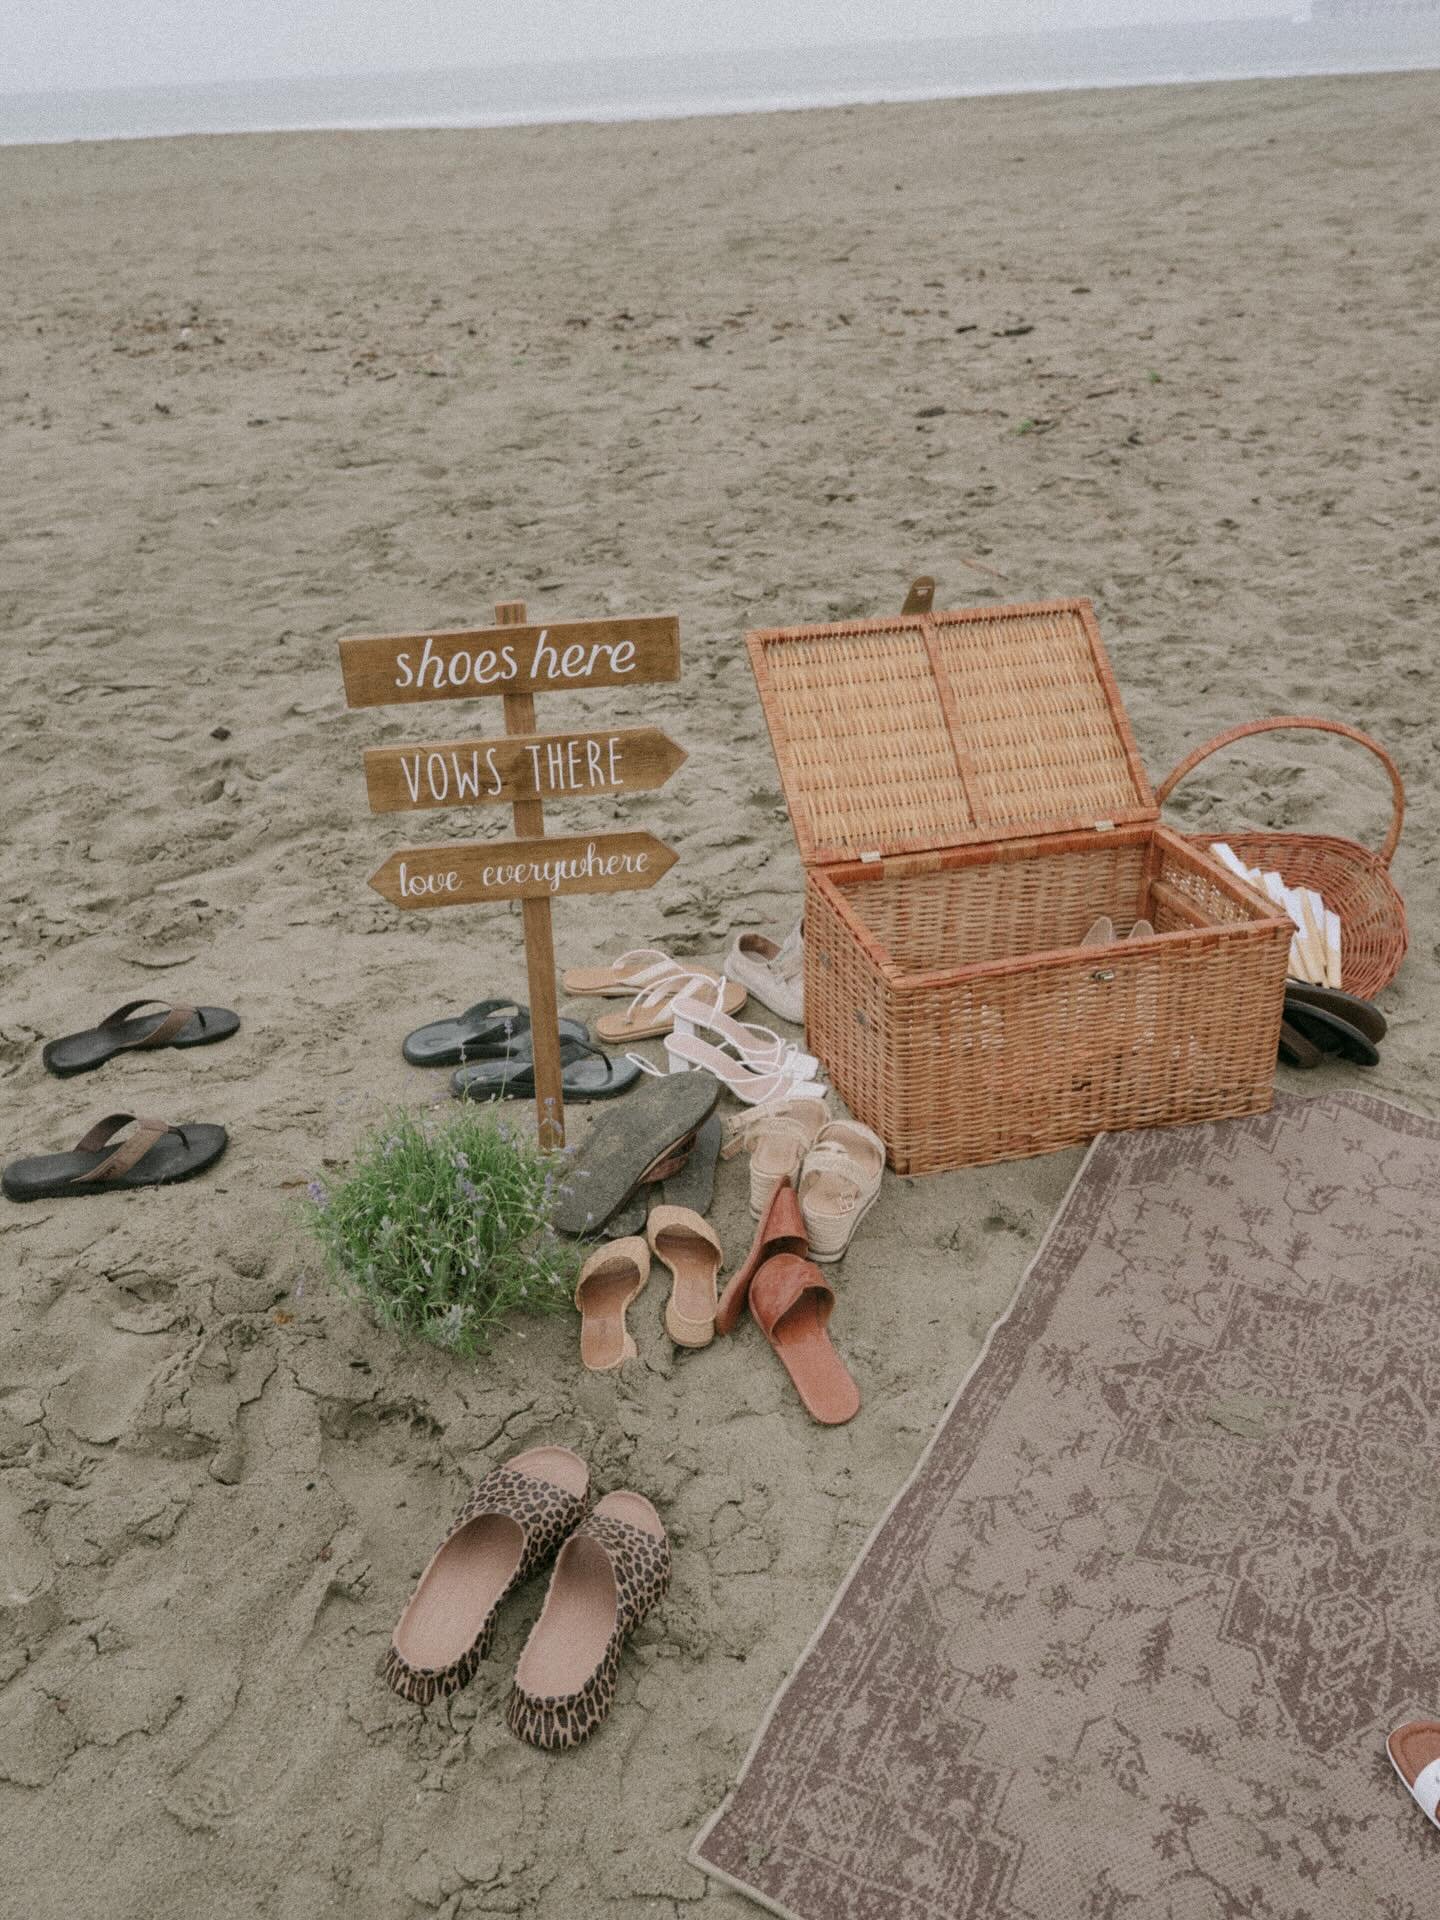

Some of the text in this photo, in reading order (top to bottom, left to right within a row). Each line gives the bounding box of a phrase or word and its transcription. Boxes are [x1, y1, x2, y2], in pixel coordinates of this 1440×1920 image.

[395, 629, 636, 689] shoes here
[400, 737, 625, 803] VOWS THERE
[399, 842, 651, 897] love everywhere
